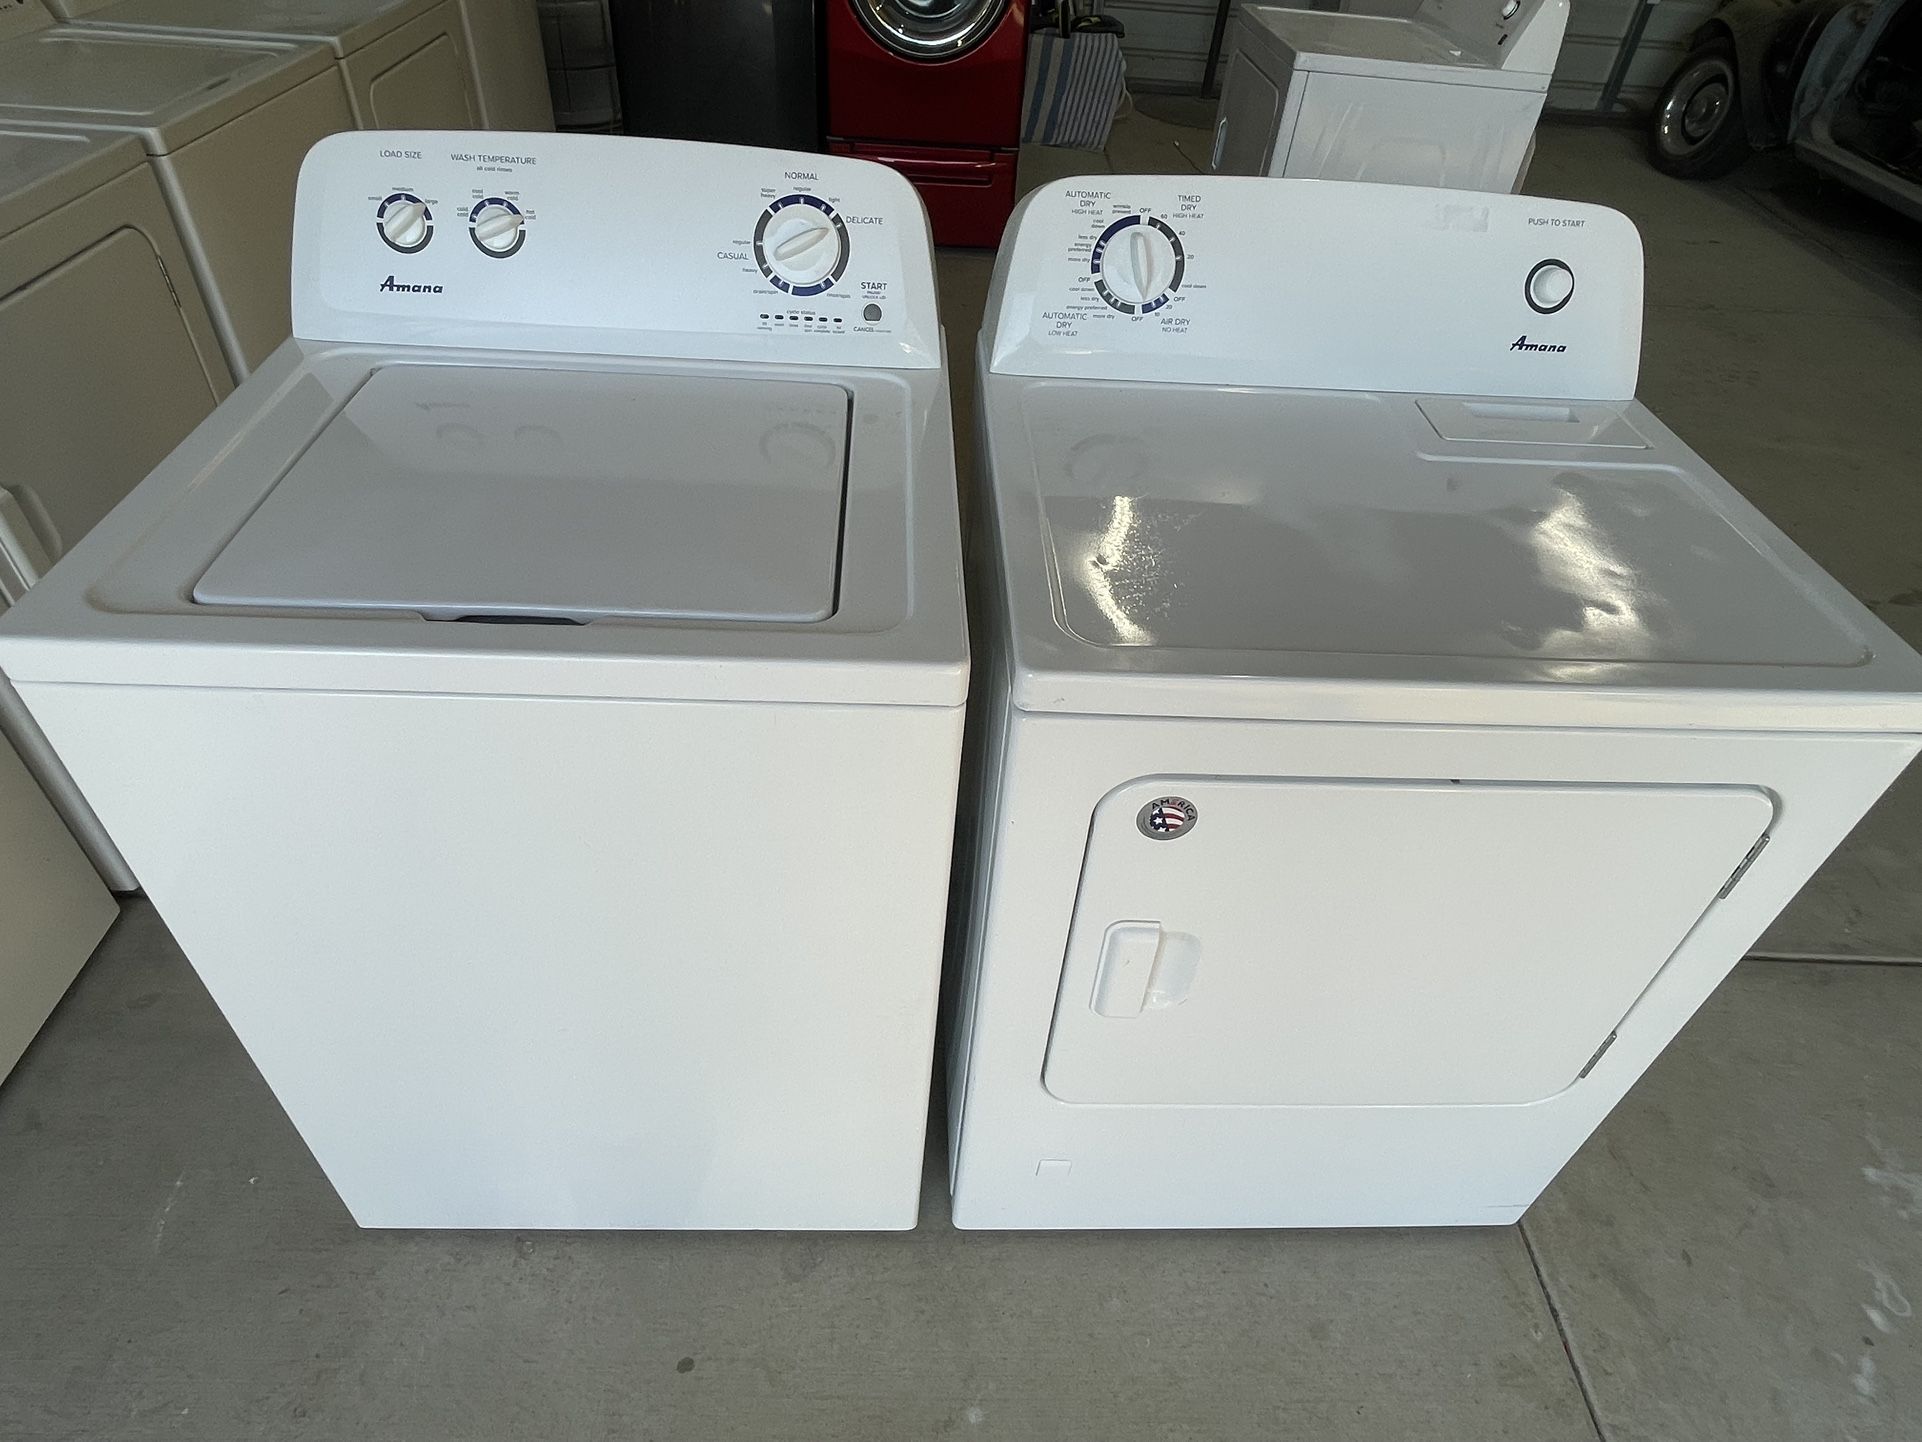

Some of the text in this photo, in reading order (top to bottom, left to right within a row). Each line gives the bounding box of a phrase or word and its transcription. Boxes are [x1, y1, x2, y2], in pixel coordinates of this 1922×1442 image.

[380, 150, 422, 159] LOAD SIZE
[451, 154, 536, 165] WASH TEMPERATURE
[784, 172, 819, 180] NORMAL
[1065, 191, 1112, 199] AUTOMATIC
[1178, 195, 1201, 203] TIMED
[845, 216, 884, 225] DELICATE
[1528, 218, 1586, 228] PUSH TO START
[717, 251, 749, 260] CASUAL
[380, 275, 444, 294] Amana
[861, 282, 888, 290] START
[1042, 312, 1088, 320] AUTOMATIC
[1056, 321, 1072, 329] DRY
[1174, 318, 1191, 326] DRY
[1510, 335, 1567, 353] Amana
